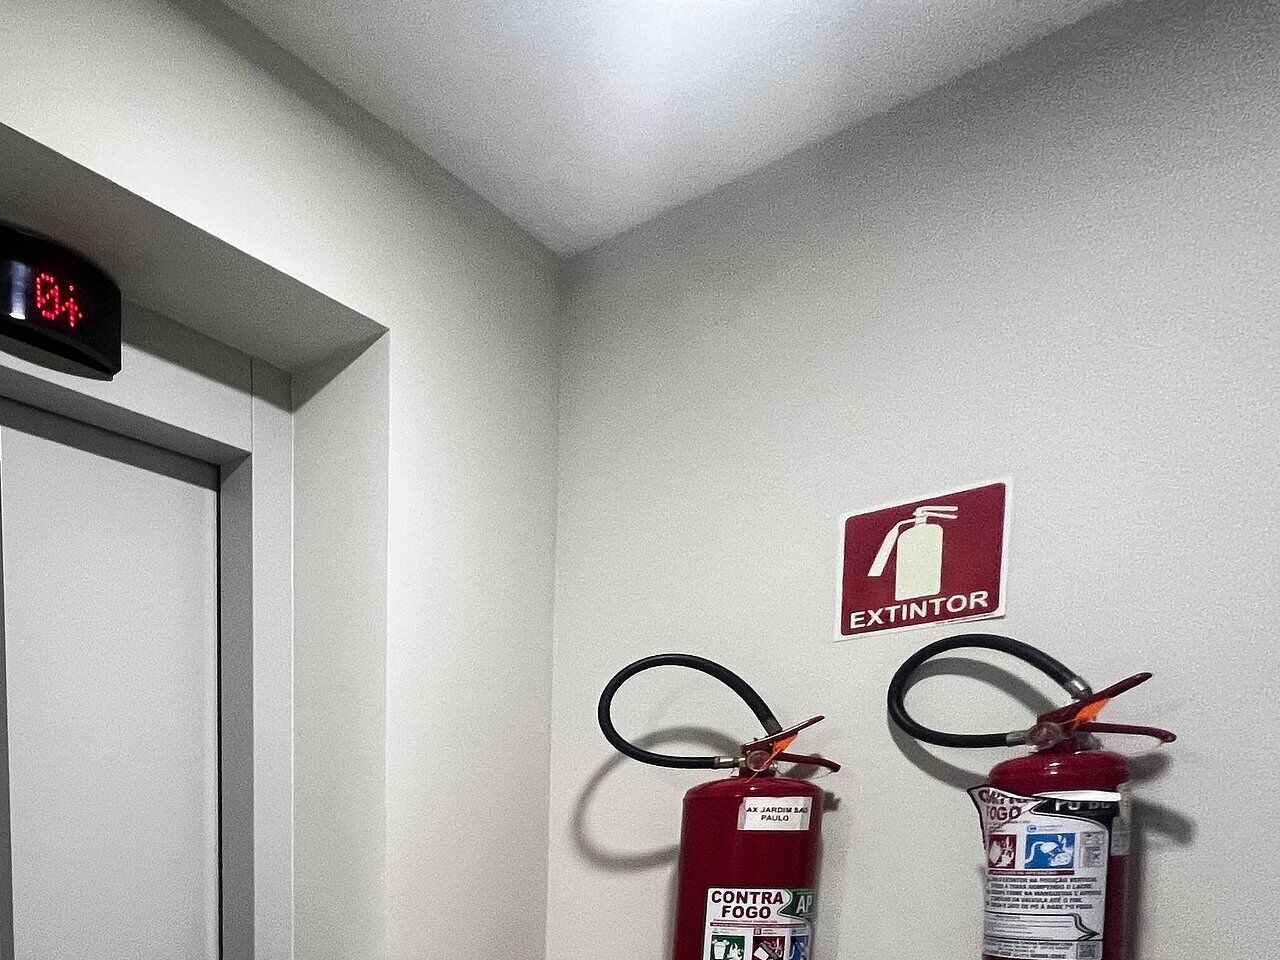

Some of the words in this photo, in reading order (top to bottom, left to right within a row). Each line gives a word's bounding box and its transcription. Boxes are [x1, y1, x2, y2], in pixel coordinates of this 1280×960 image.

[850, 590, 989, 629] EXTINTOR
[760, 814, 790, 822] PAULO
[711, 890, 784, 905] CONTRA
[721, 905, 772, 919] FOGO
